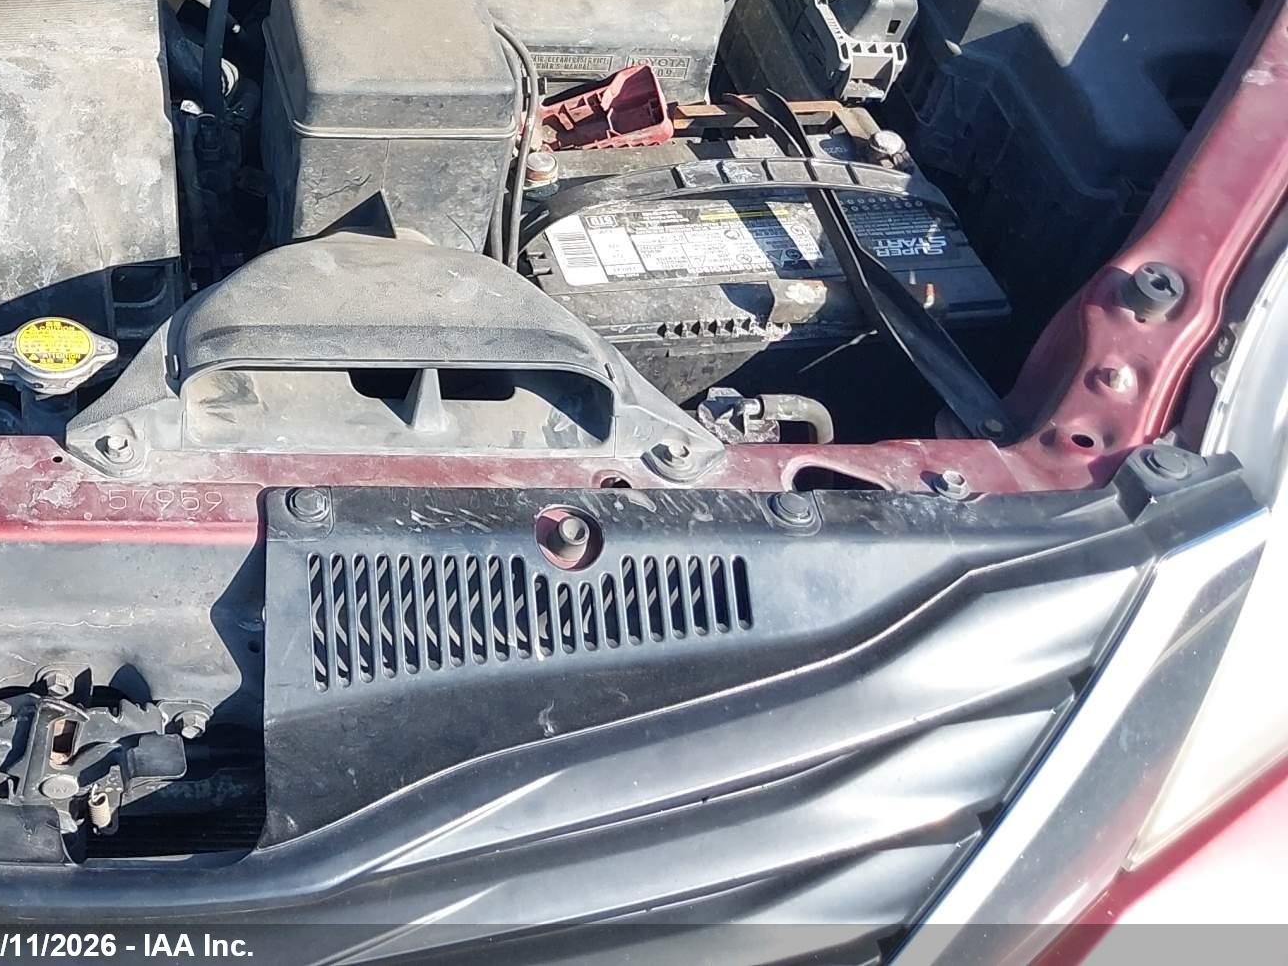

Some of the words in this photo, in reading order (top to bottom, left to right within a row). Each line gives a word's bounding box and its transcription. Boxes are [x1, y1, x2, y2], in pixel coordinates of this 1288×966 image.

[629, 57, 686, 68] TOYOTA
[870, 236, 948, 250] START
[874, 247, 944, 258] SUPER
[108, 489, 223, 512] 57959
